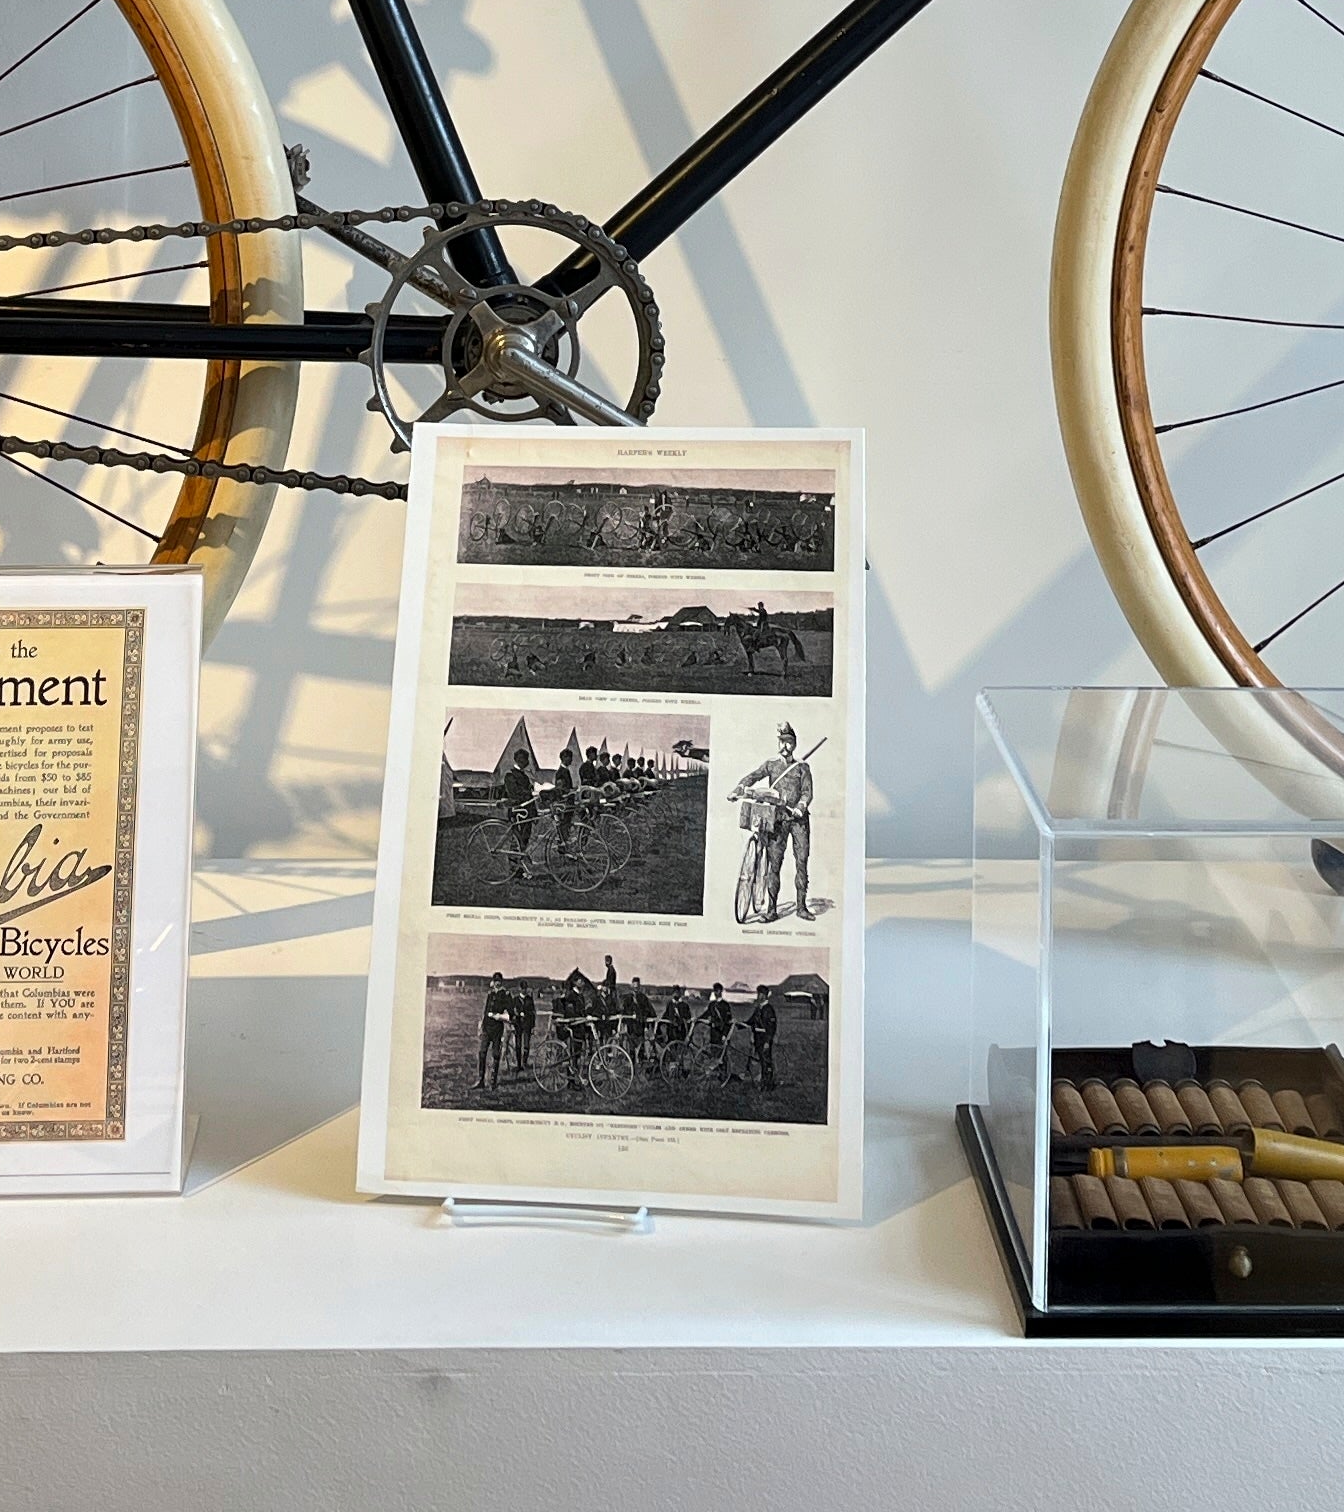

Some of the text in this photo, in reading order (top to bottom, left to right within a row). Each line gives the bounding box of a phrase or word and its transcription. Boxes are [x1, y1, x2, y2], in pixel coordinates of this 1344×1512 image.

[10, 639, 38, 659] the
[25, 725, 63, 733] proposes
[66, 724, 76, 732] to
[78, 724, 94, 732] test
[30, 735, 44, 745] for
[47, 737, 73, 746] army
[33, 747, 47, 757] for
[51, 747, 93, 759] proposals
[3, 966, 65, 980] WORLD
[21, 1071, 44, 1085] CO.
